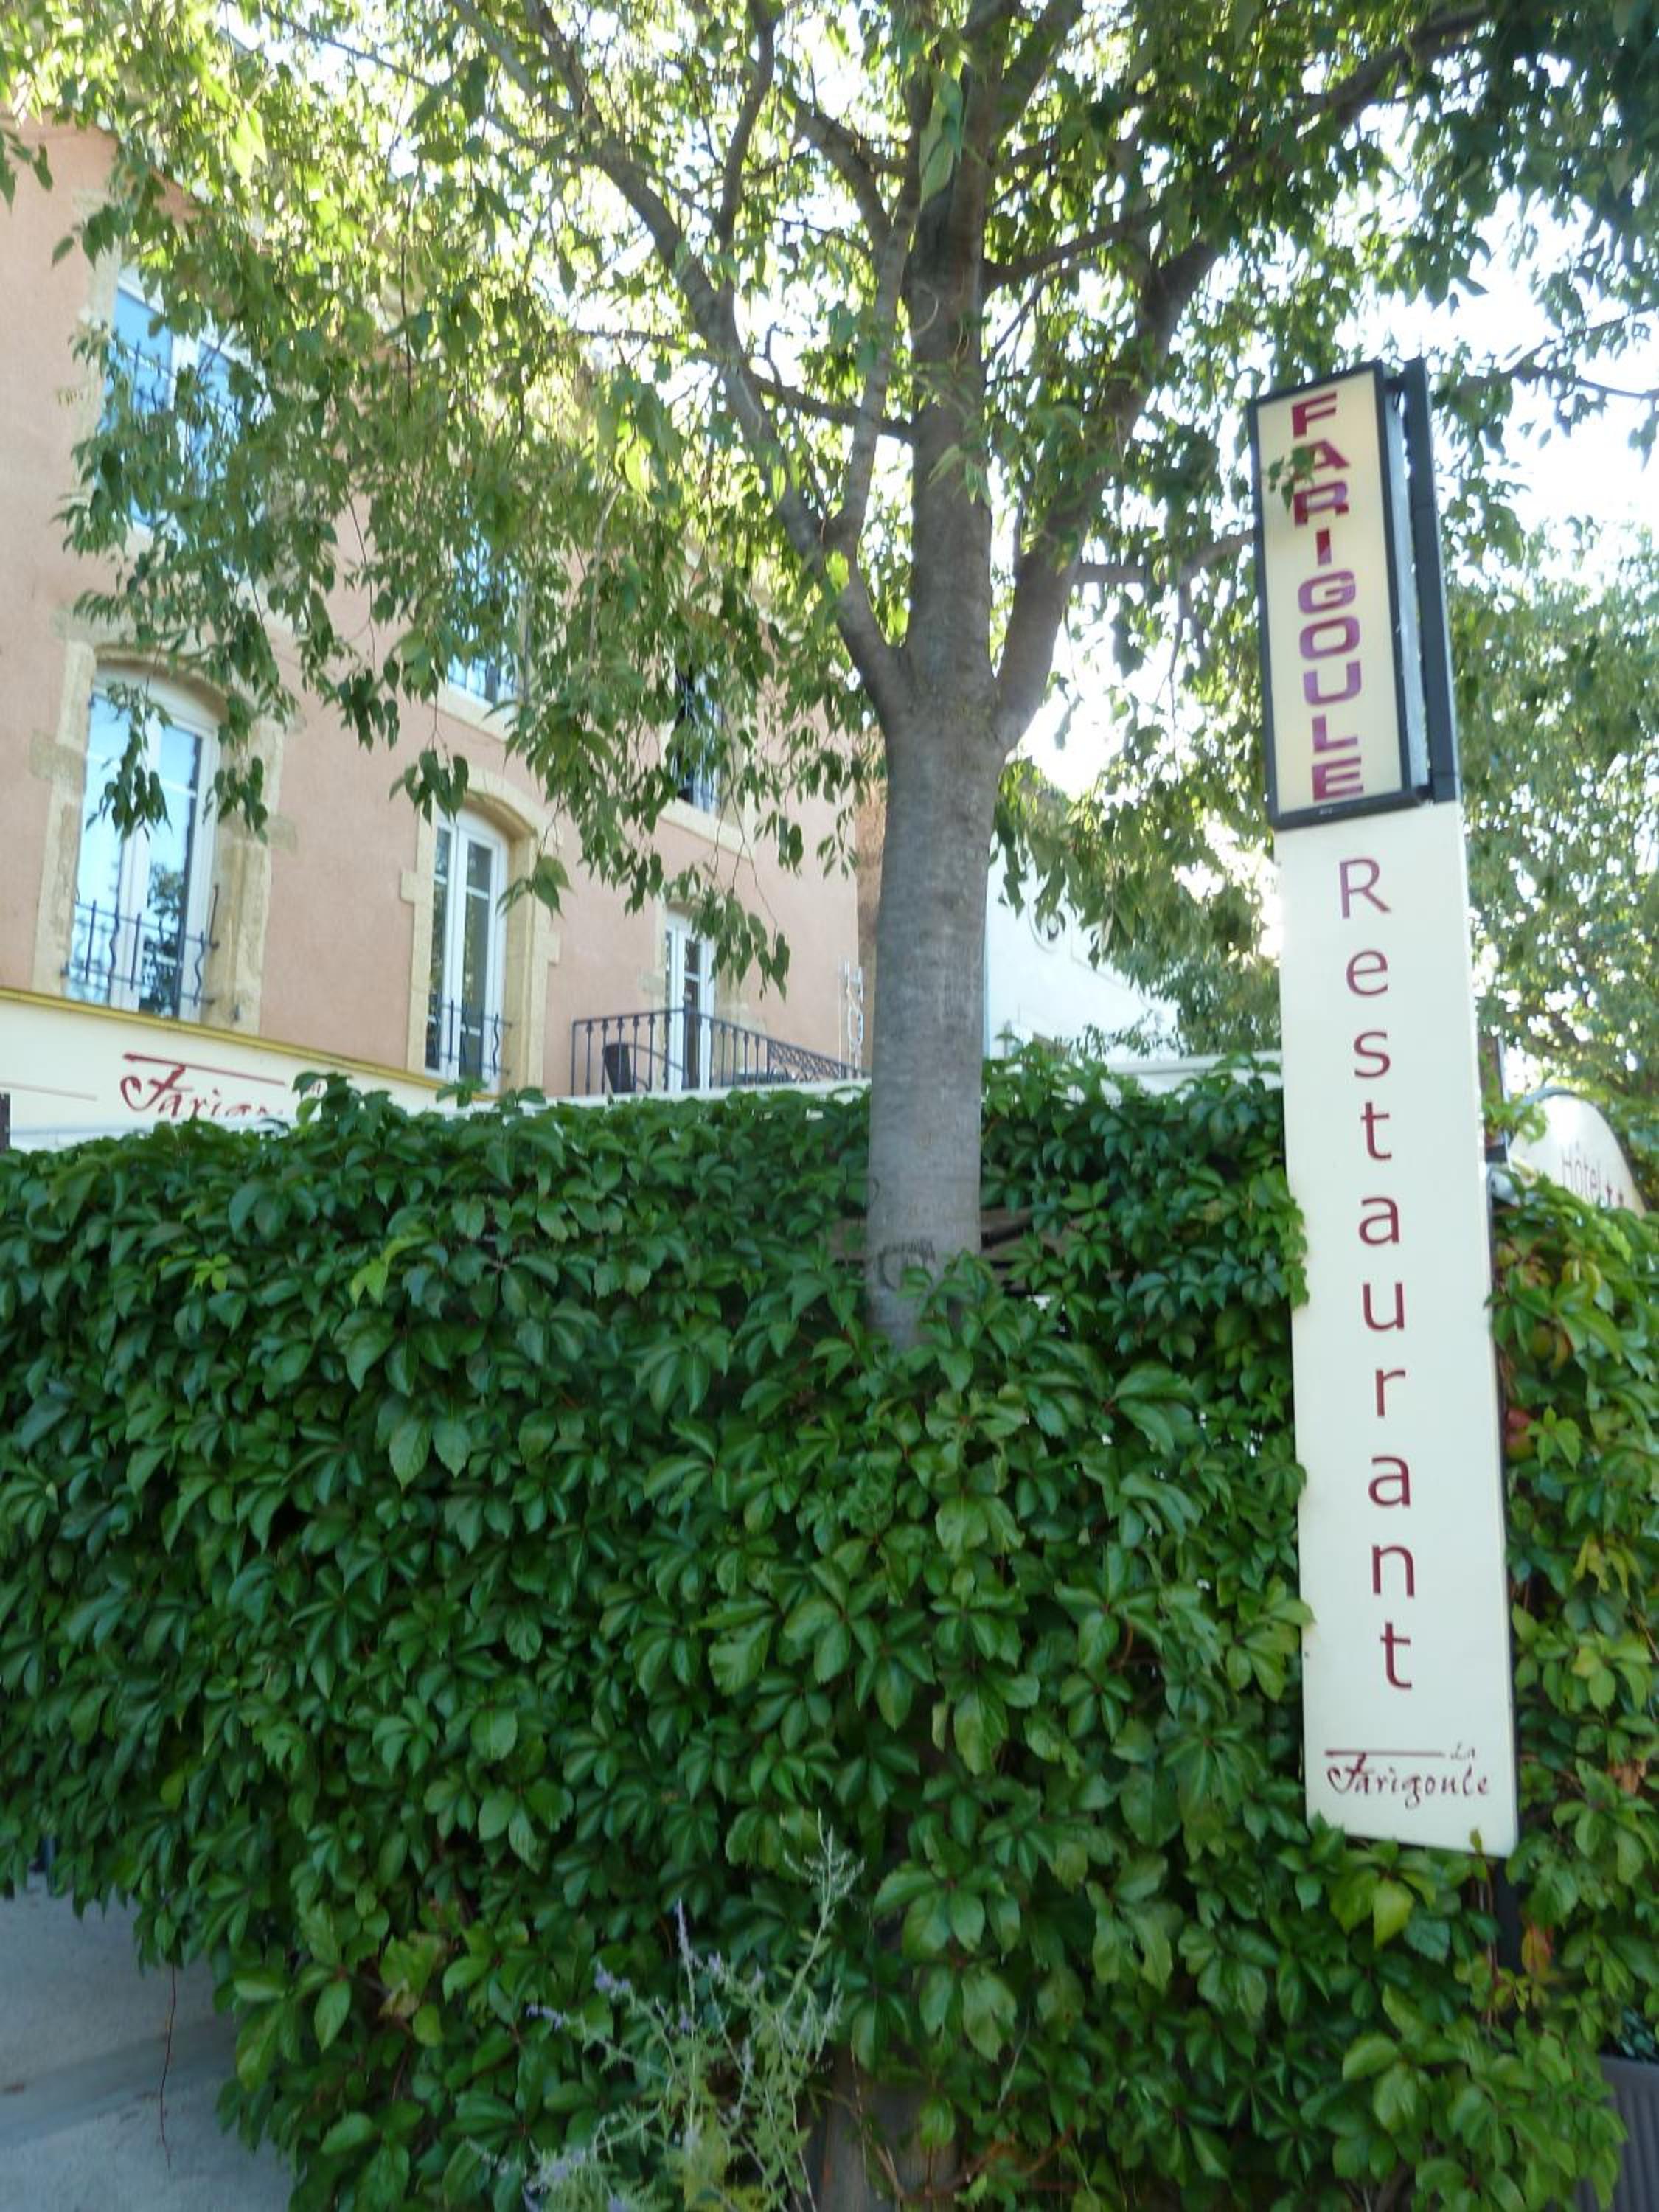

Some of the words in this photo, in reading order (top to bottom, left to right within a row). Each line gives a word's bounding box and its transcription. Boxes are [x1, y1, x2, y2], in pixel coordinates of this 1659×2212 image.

[1291, 392, 1364, 803] FARIGOULE
[1338, 857, 1415, 1691] Restaurant
[1324, 1749, 1489, 1810] Farigoule
